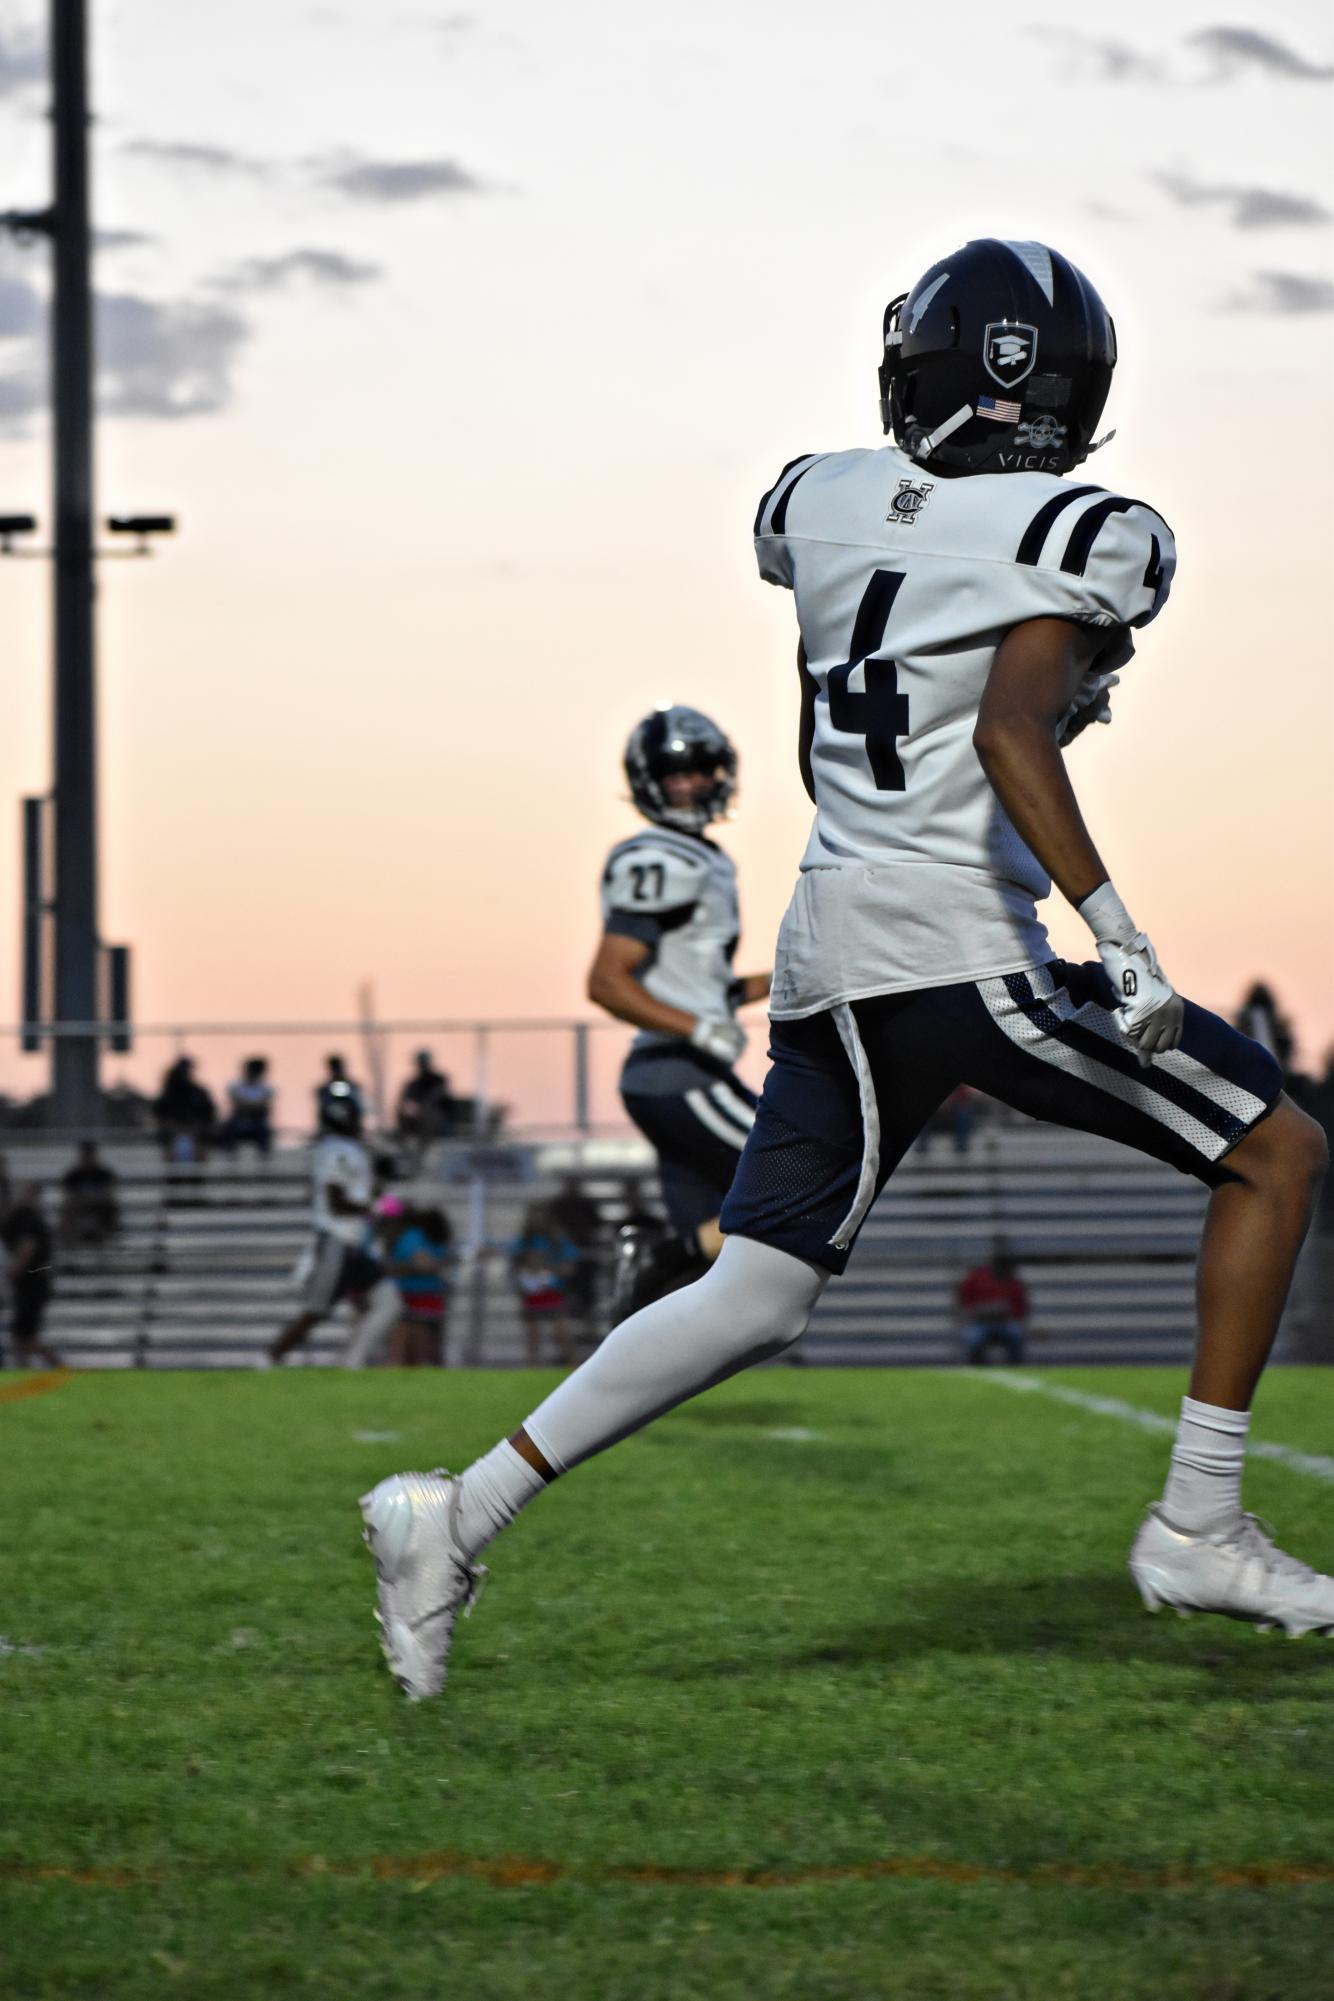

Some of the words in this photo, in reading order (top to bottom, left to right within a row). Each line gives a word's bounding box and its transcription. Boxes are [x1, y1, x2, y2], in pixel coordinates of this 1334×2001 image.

[998, 452, 1060, 470] VICIS
[827, 568, 911, 792] 4
[629, 863, 665, 900] 27
